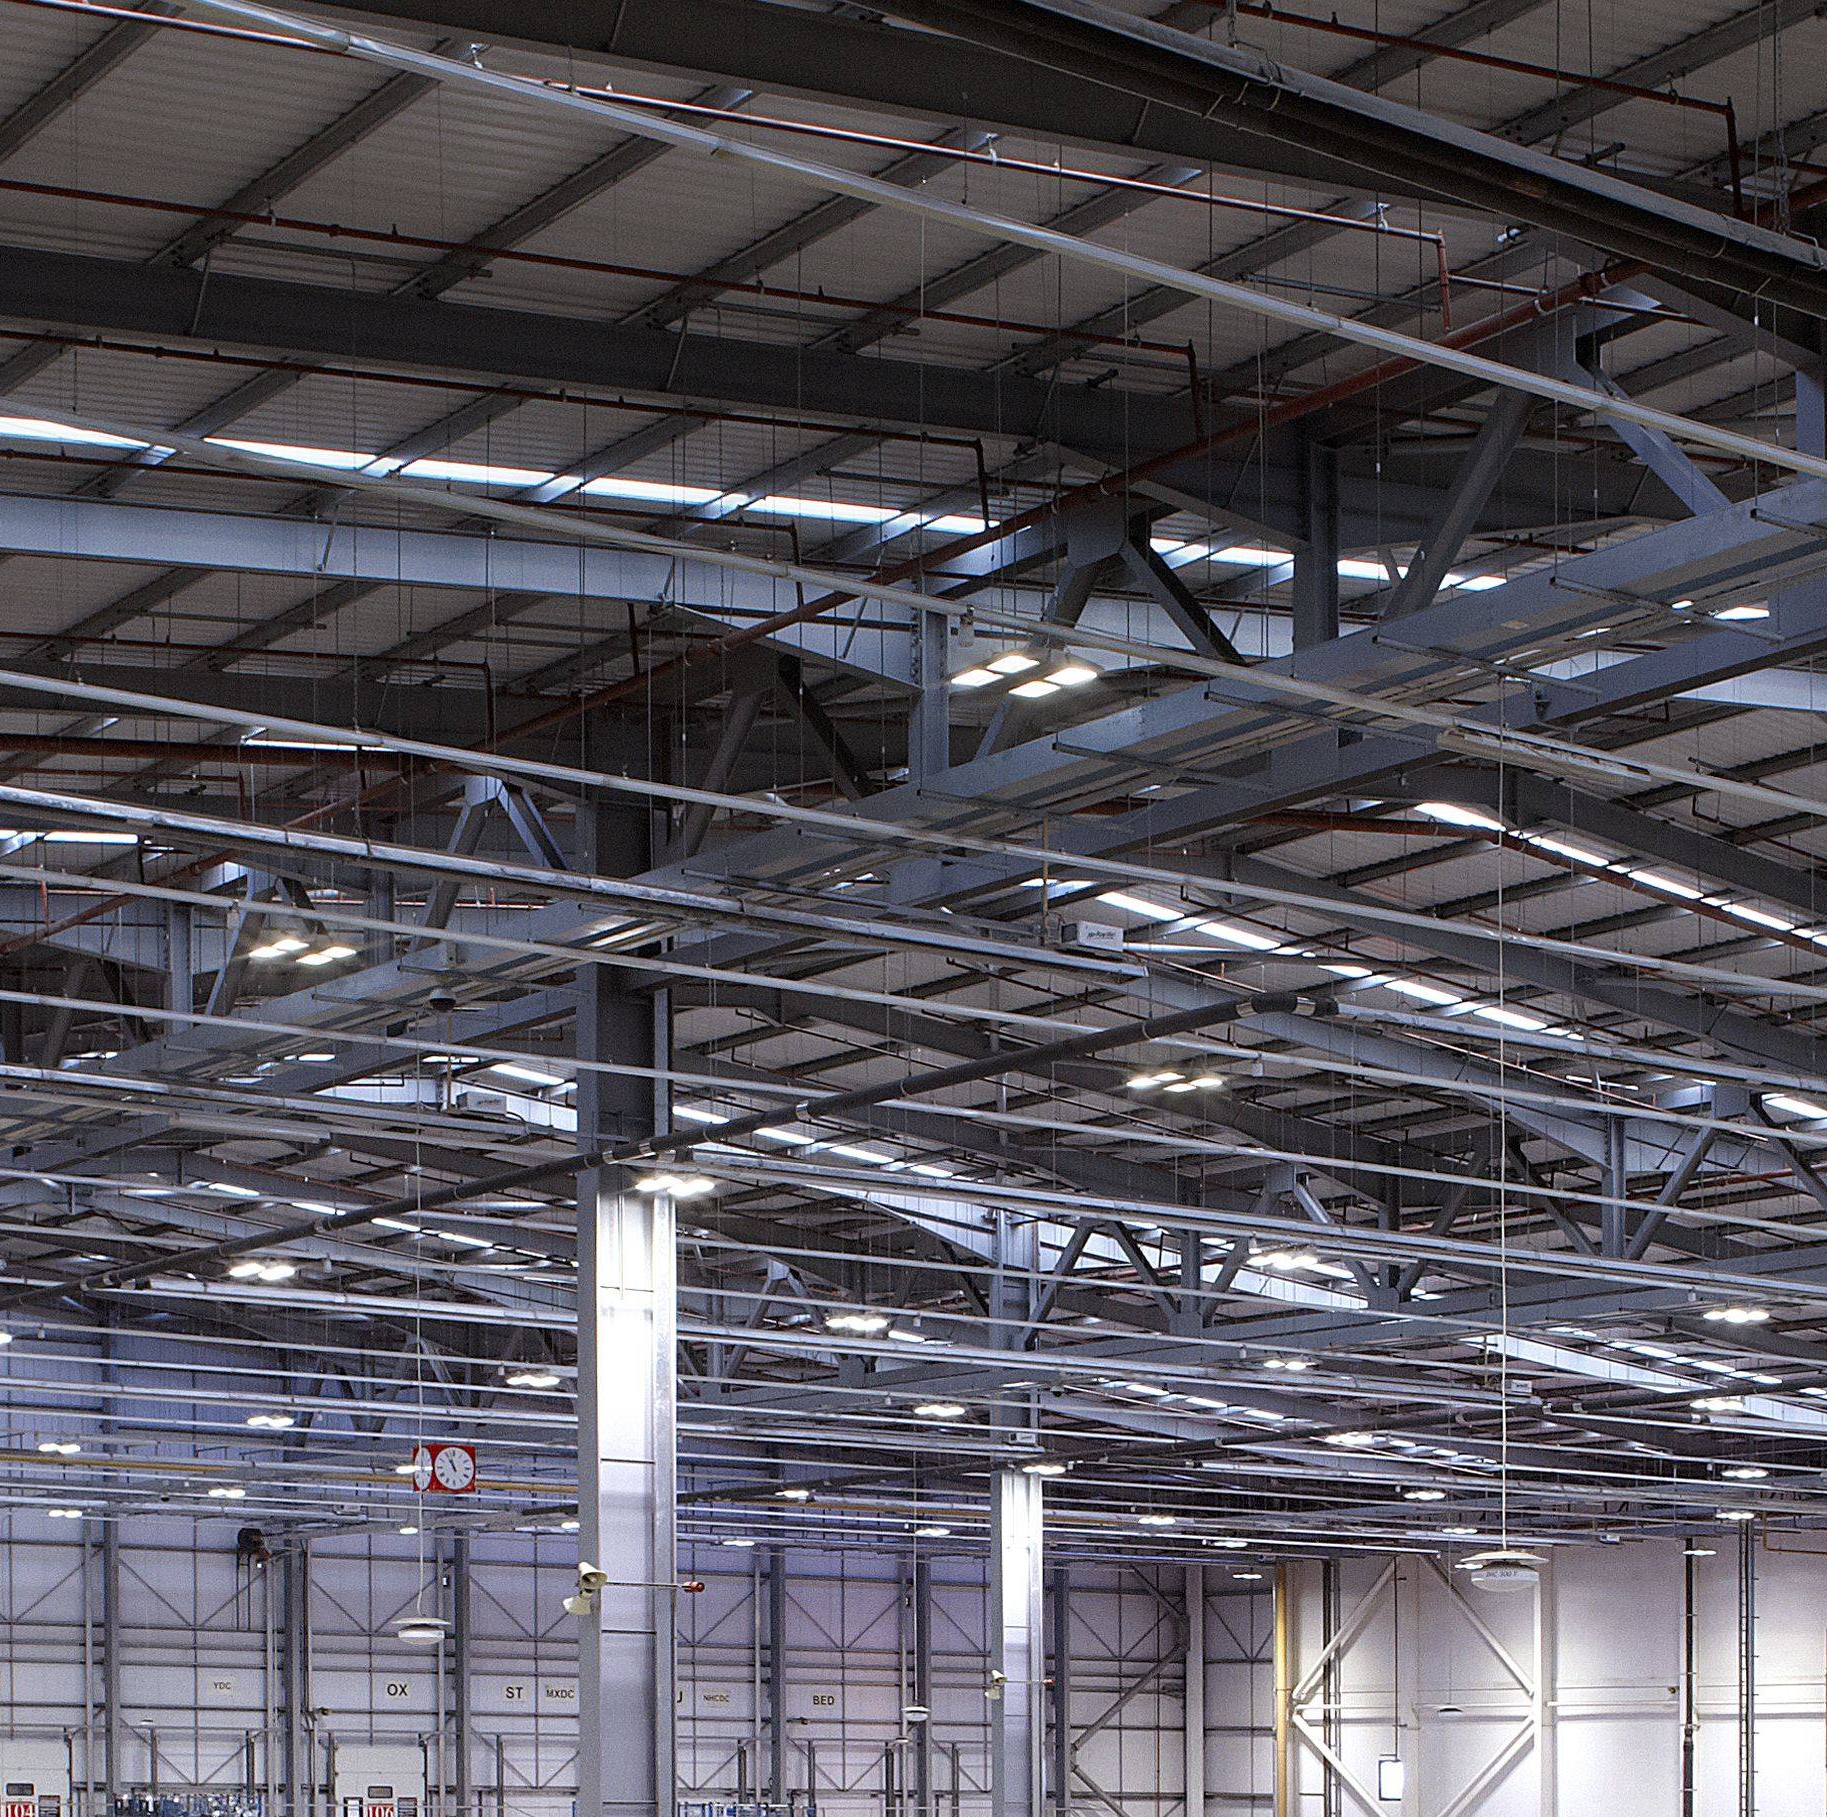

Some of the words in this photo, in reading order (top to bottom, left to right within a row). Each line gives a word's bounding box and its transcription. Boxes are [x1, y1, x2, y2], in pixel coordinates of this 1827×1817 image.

[387, 1684, 408, 1696] OX
[505, 1687, 523, 1699] ST
[546, 1689, 575, 1698] MXDC
[812, 1695, 835, 1706] BED
